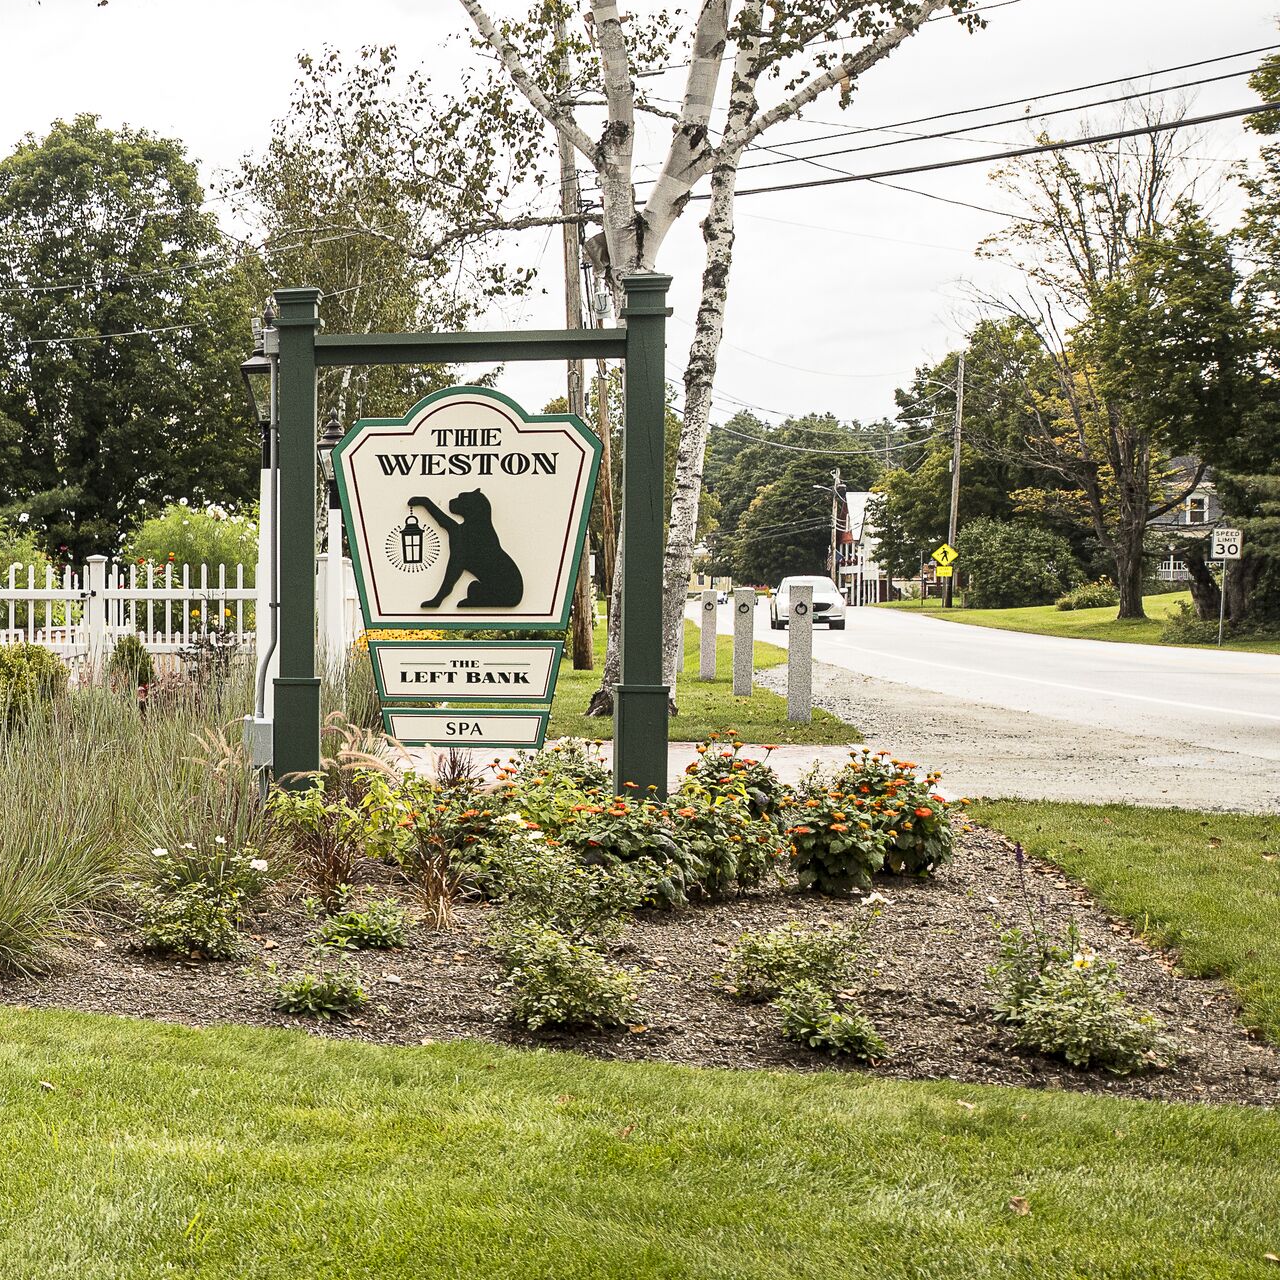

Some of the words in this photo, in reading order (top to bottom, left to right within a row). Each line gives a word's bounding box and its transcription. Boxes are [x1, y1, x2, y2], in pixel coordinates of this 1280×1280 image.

[431, 428, 502, 447] THE
[375, 452, 559, 475] WESTON
[1215, 544, 1238, 555] 30
[450, 660, 480, 668] THE
[400, 671, 458, 683] LEFT
[465, 671, 530, 684] BANK
[445, 721, 483, 736] SPA
